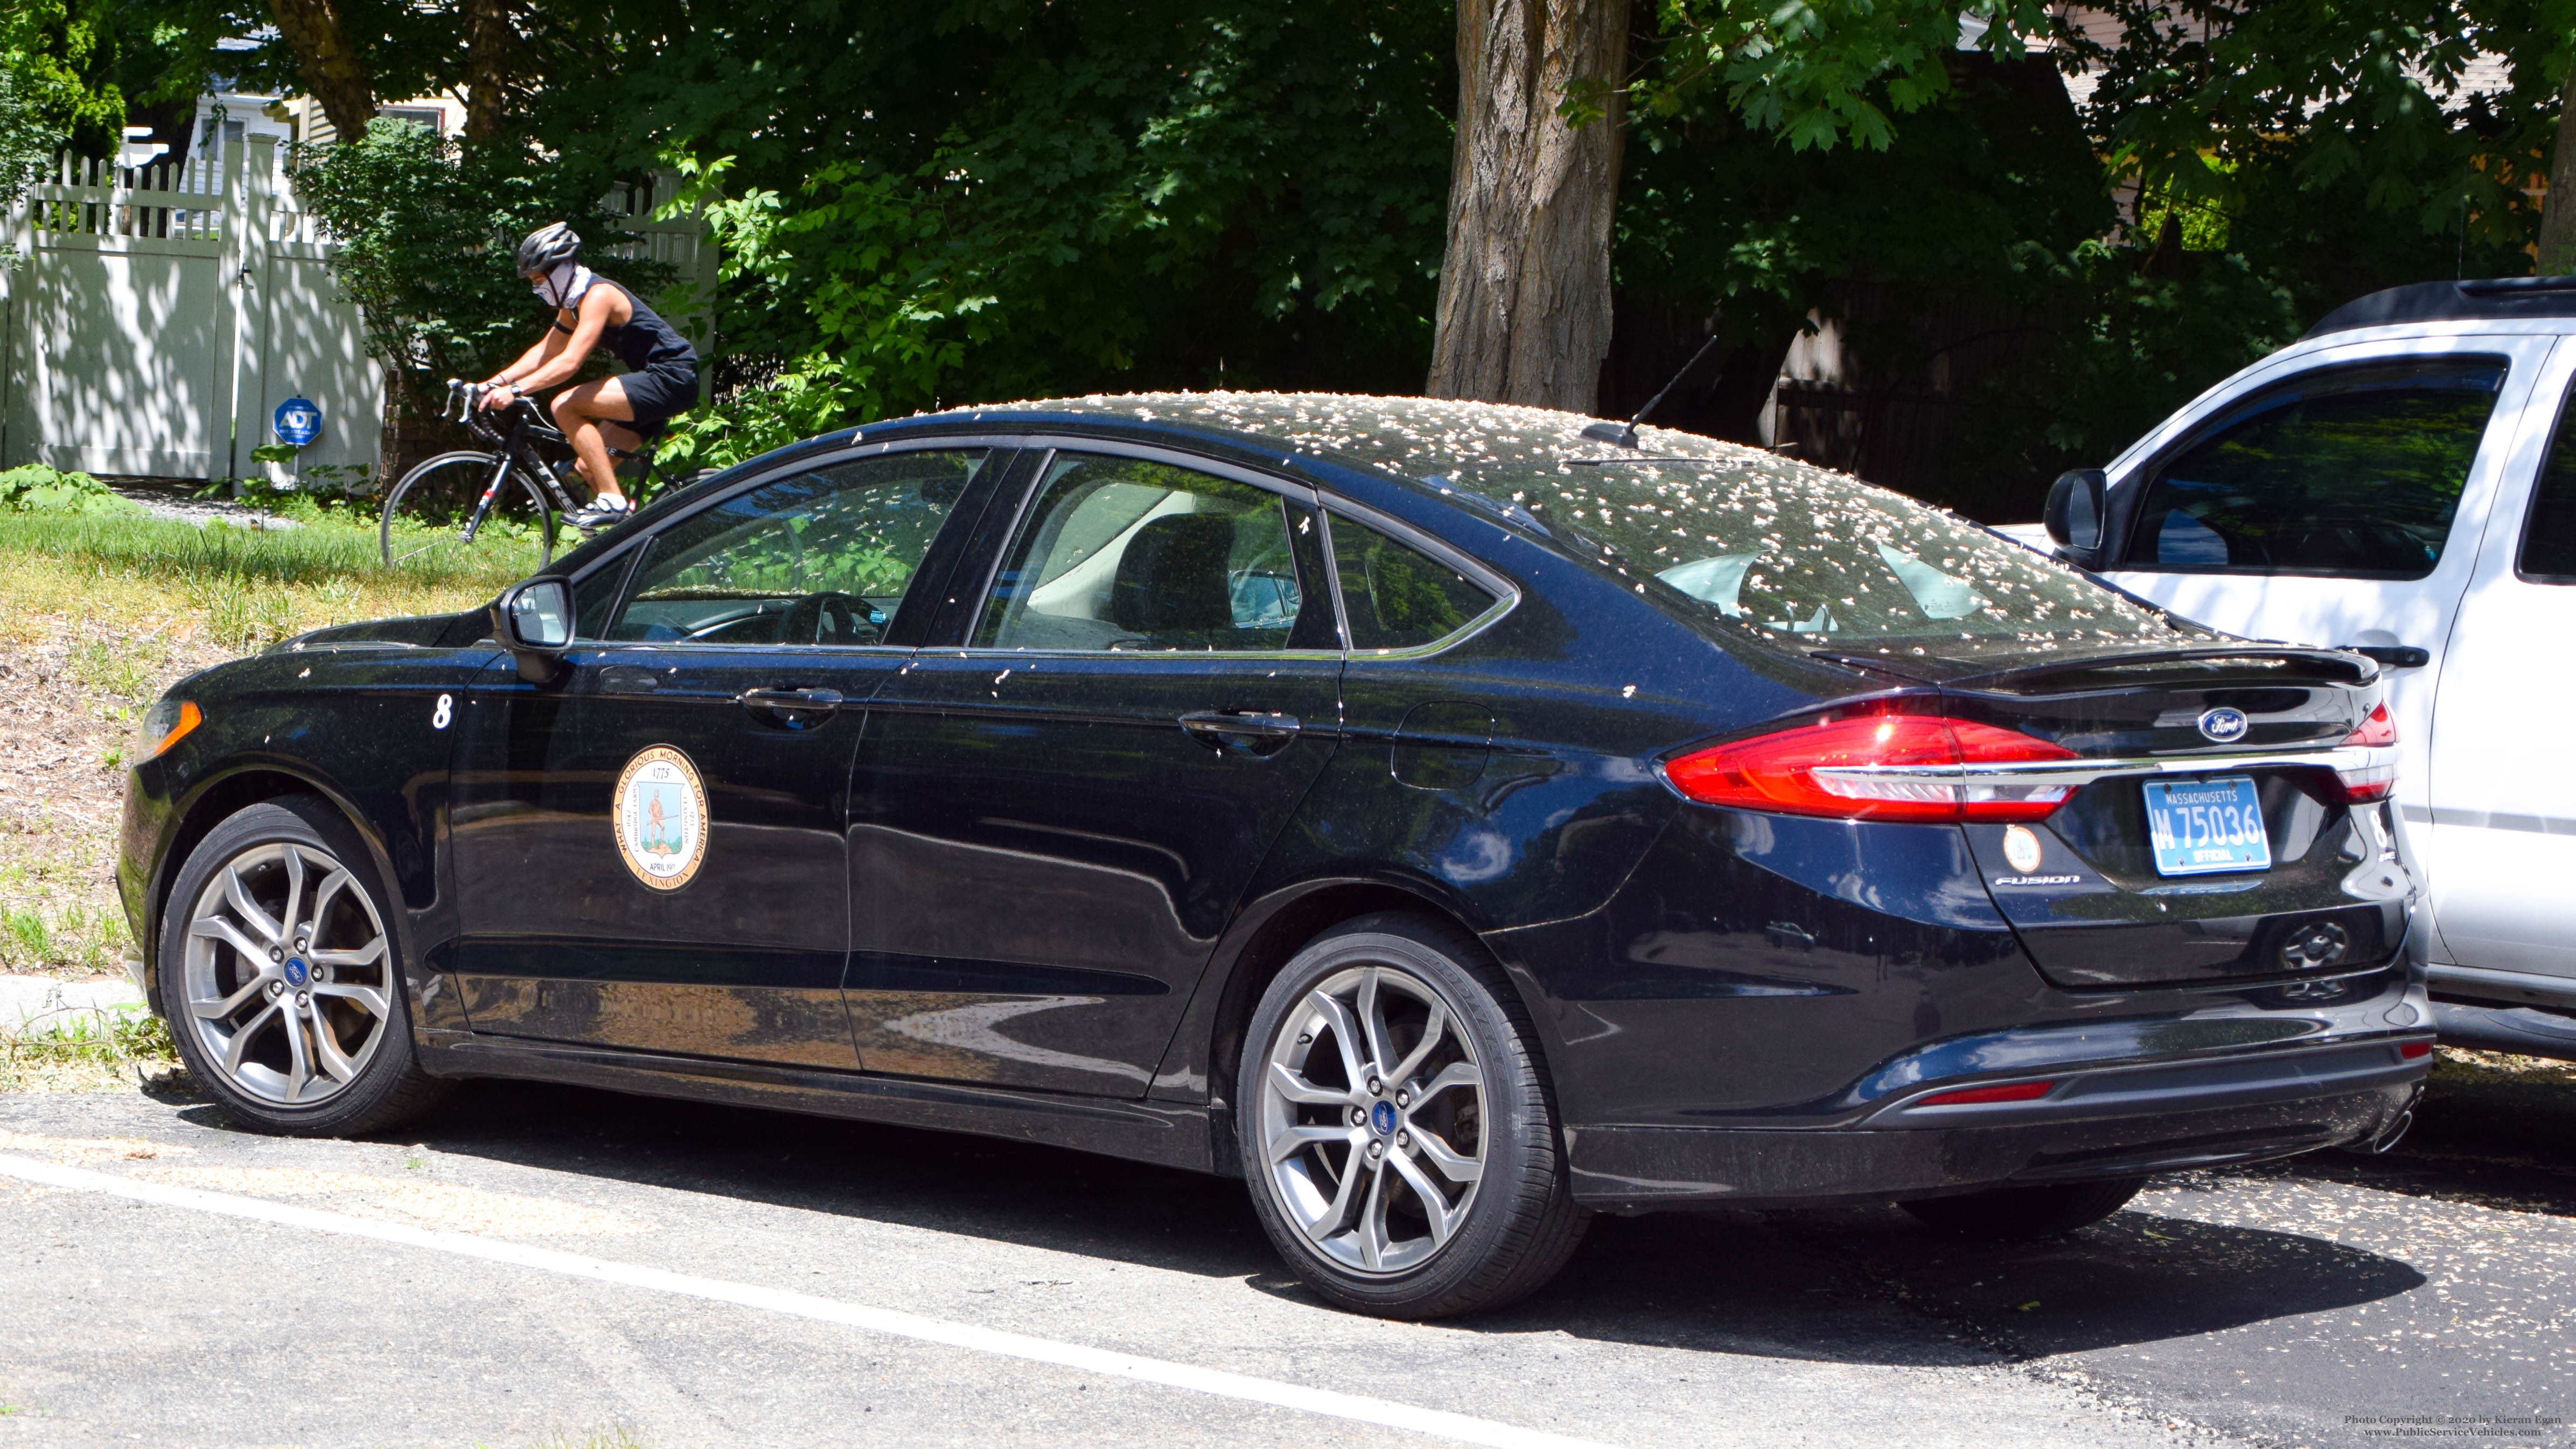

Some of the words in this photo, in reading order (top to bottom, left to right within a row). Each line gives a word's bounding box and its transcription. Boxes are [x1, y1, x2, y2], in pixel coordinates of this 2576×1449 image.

[279, 410, 317, 429] ADT
[433, 694, 452, 729] 8
[2211, 714, 2238, 733] Ford
[618, 751, 654, 793] GLORIOUS
[659, 750, 695, 781] MORNING
[693, 784, 704, 807] FOR
[653, 767, 670, 779] 1775
[2166, 790, 2238, 805] MASSACHUSETTS
[2176, 804, 2260, 849] 75036
[2370, 810, 2387, 847] 8
[2193, 848, 2234, 863] OFFICIAL
[650, 863, 665, 871] APRIL
[636, 867, 689, 888] LEXINGTON
[1995, 874, 2081, 886] FUSION
